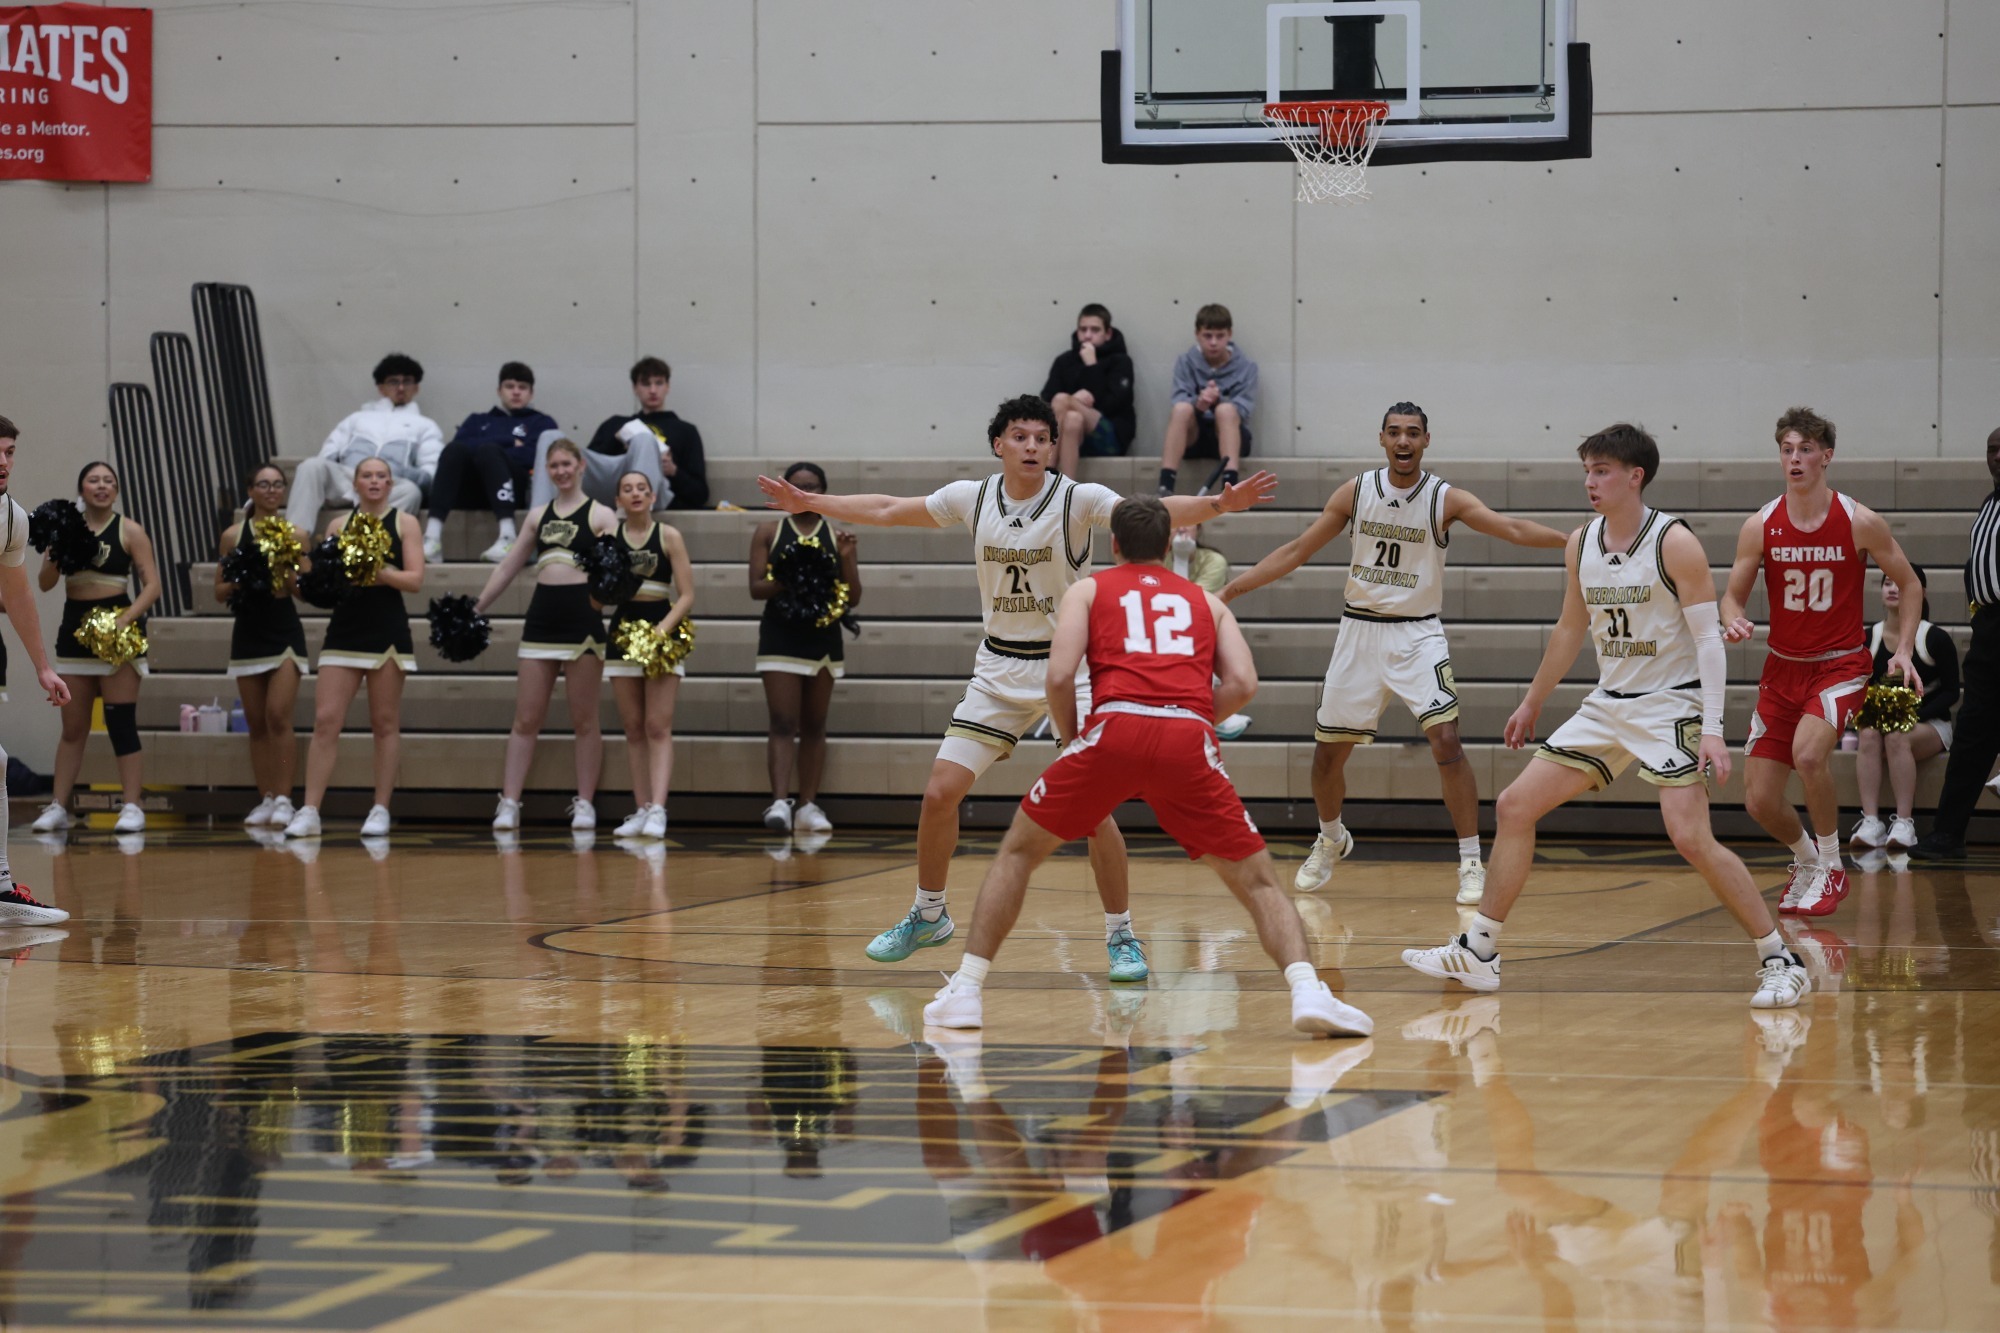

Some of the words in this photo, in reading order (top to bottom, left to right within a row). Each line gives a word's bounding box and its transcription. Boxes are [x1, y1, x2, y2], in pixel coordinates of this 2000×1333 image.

[16, 123, 26, 136] a
[31, 120, 90, 137] Mentor.
[1358, 520, 1427, 543] NEBRASKA
[983, 546, 1052, 566] NEBRASKA
[1374, 540, 1401, 568] 20
[1770, 546, 1846, 562] CENTRAL
[1352, 564, 1419, 588] WESLEYAN
[1586, 585, 1651, 605] NEBRASKA
[1783, 568, 1834, 612] 20
[1118, 589, 1195, 656] 12
